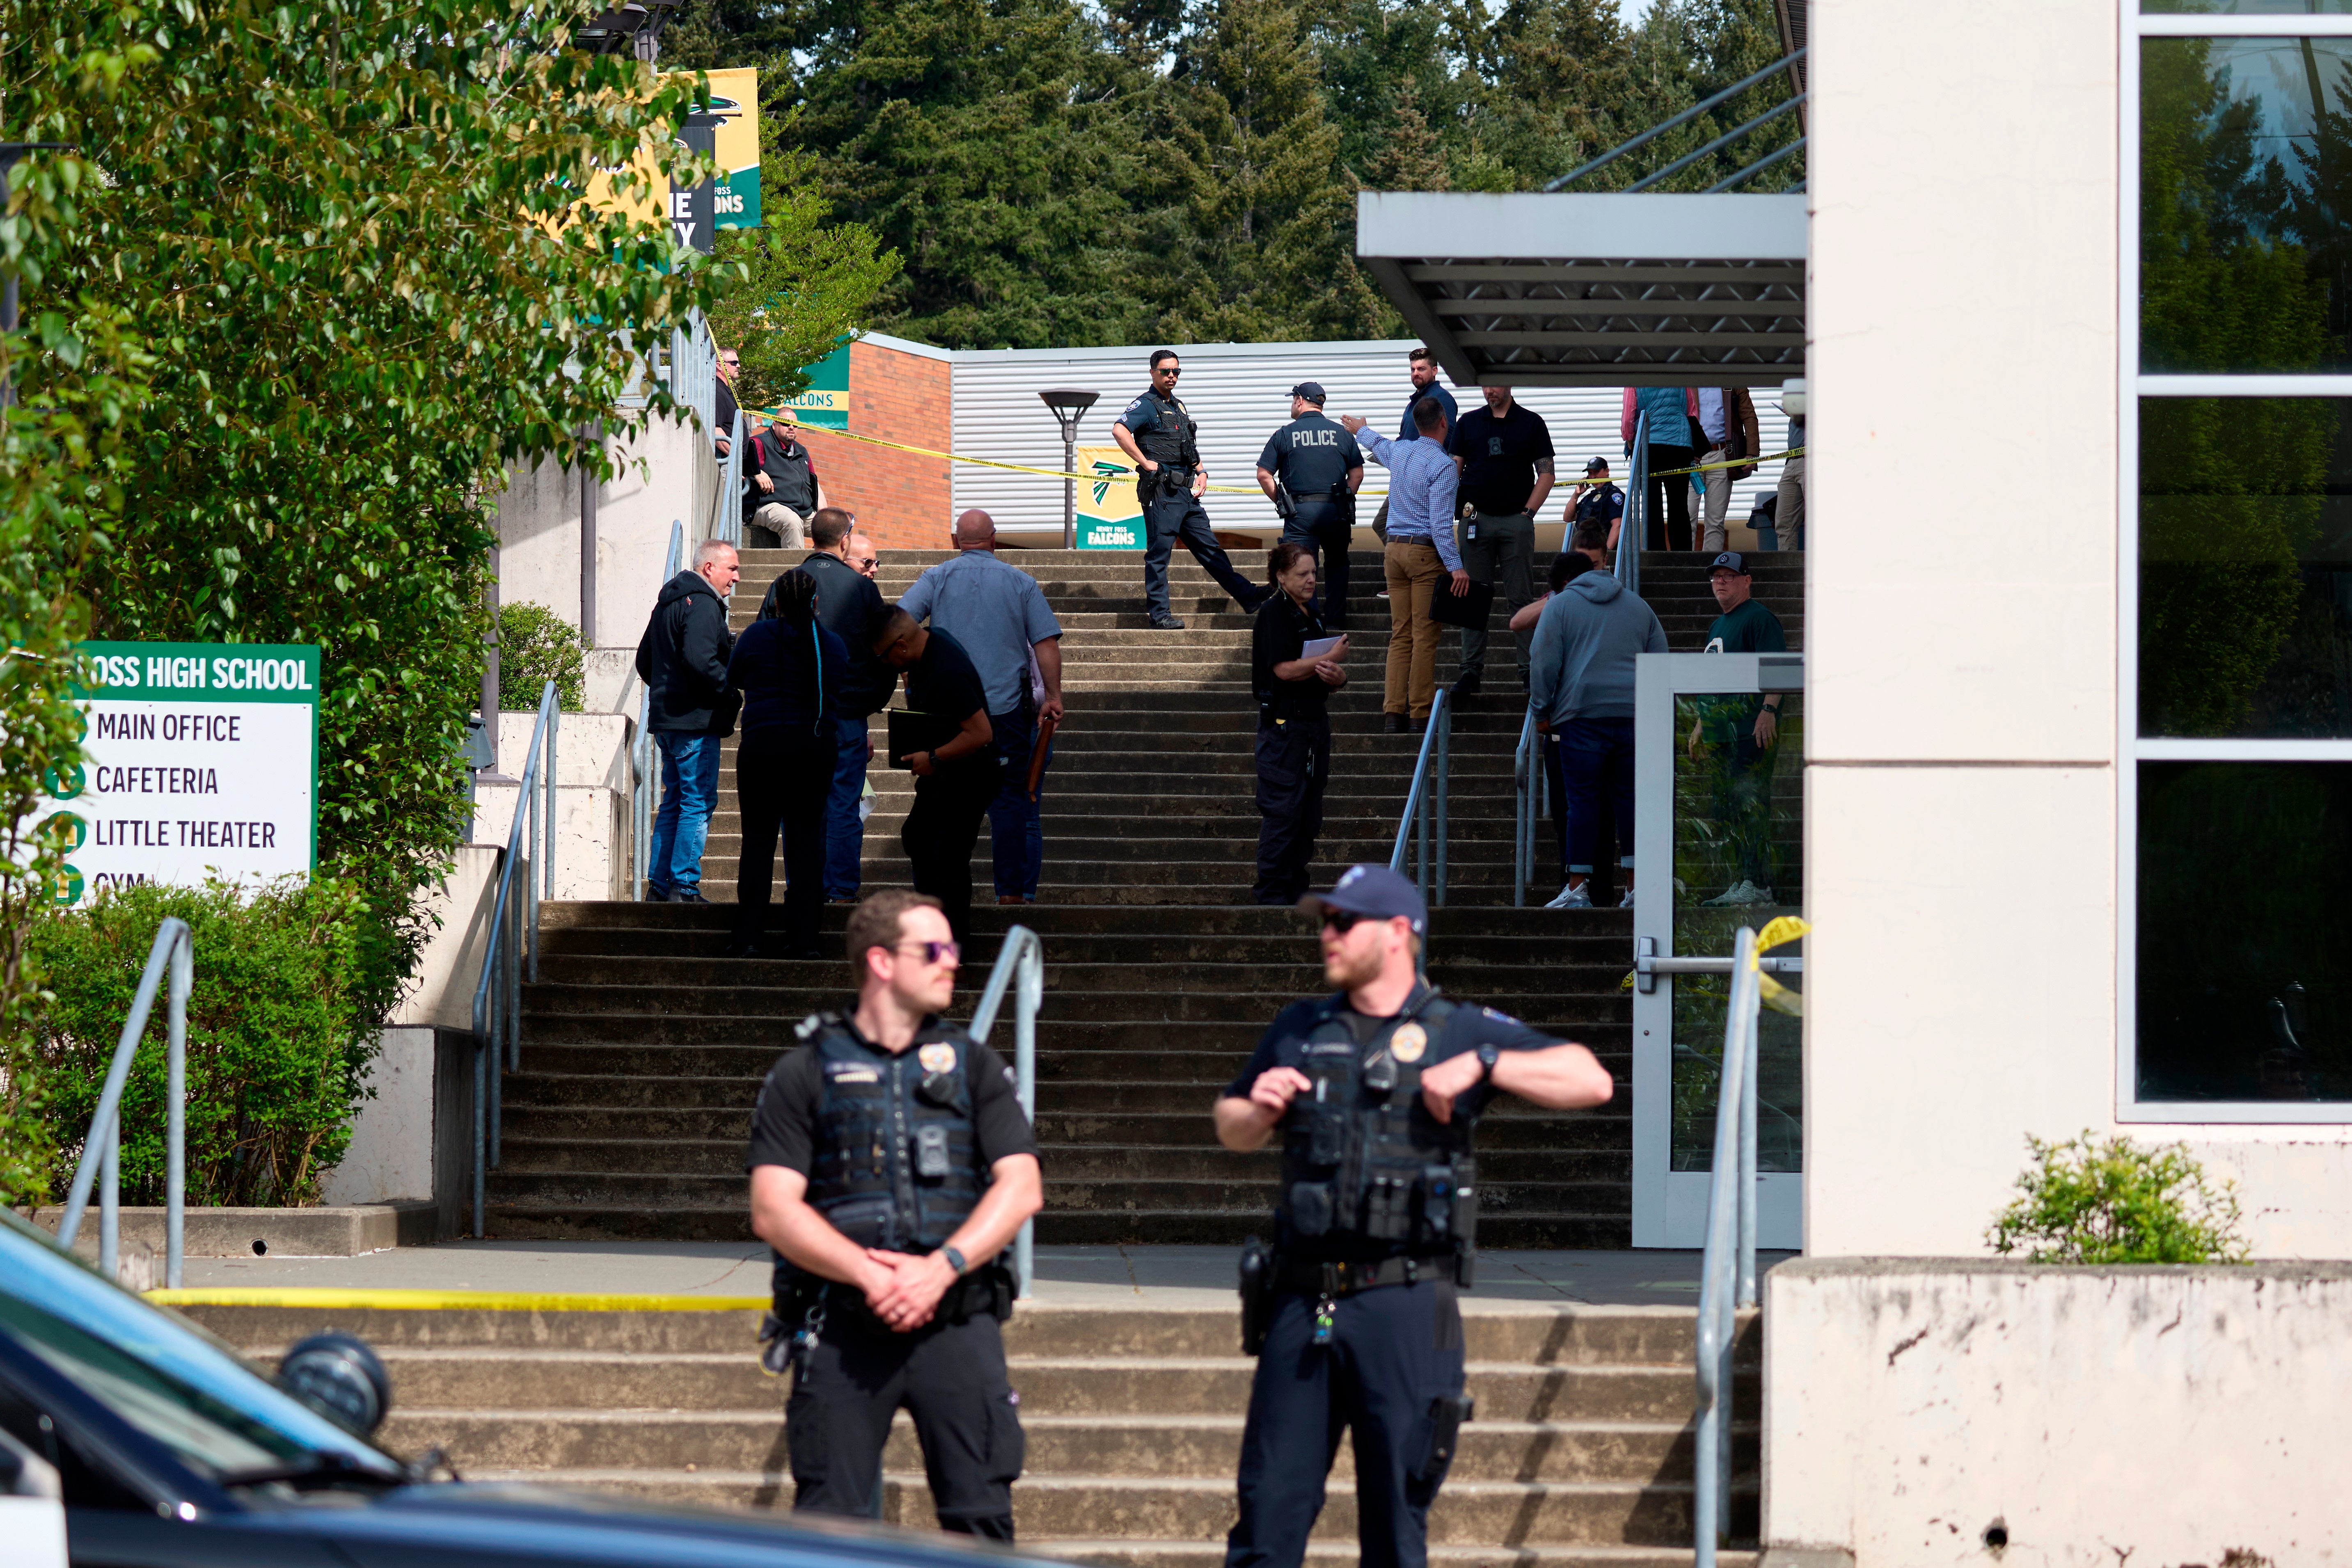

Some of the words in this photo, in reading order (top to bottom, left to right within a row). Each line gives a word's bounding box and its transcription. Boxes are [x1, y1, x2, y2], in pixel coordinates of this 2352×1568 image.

[782, 393, 833, 407] ALCONS
[1292, 430, 1337, 448] POLICE
[1087, 531, 1136, 545] FALCONS
[147, 657, 206, 688] HIGH
[212, 657, 312, 690] SCHOOL
[98, 713, 155, 739] MAIN
[163, 714, 240, 742] OFFICE
[96, 766, 218, 794] CAFETERIA
[96, 820, 169, 846] LITTLE
[177, 821, 275, 848] THEATER
